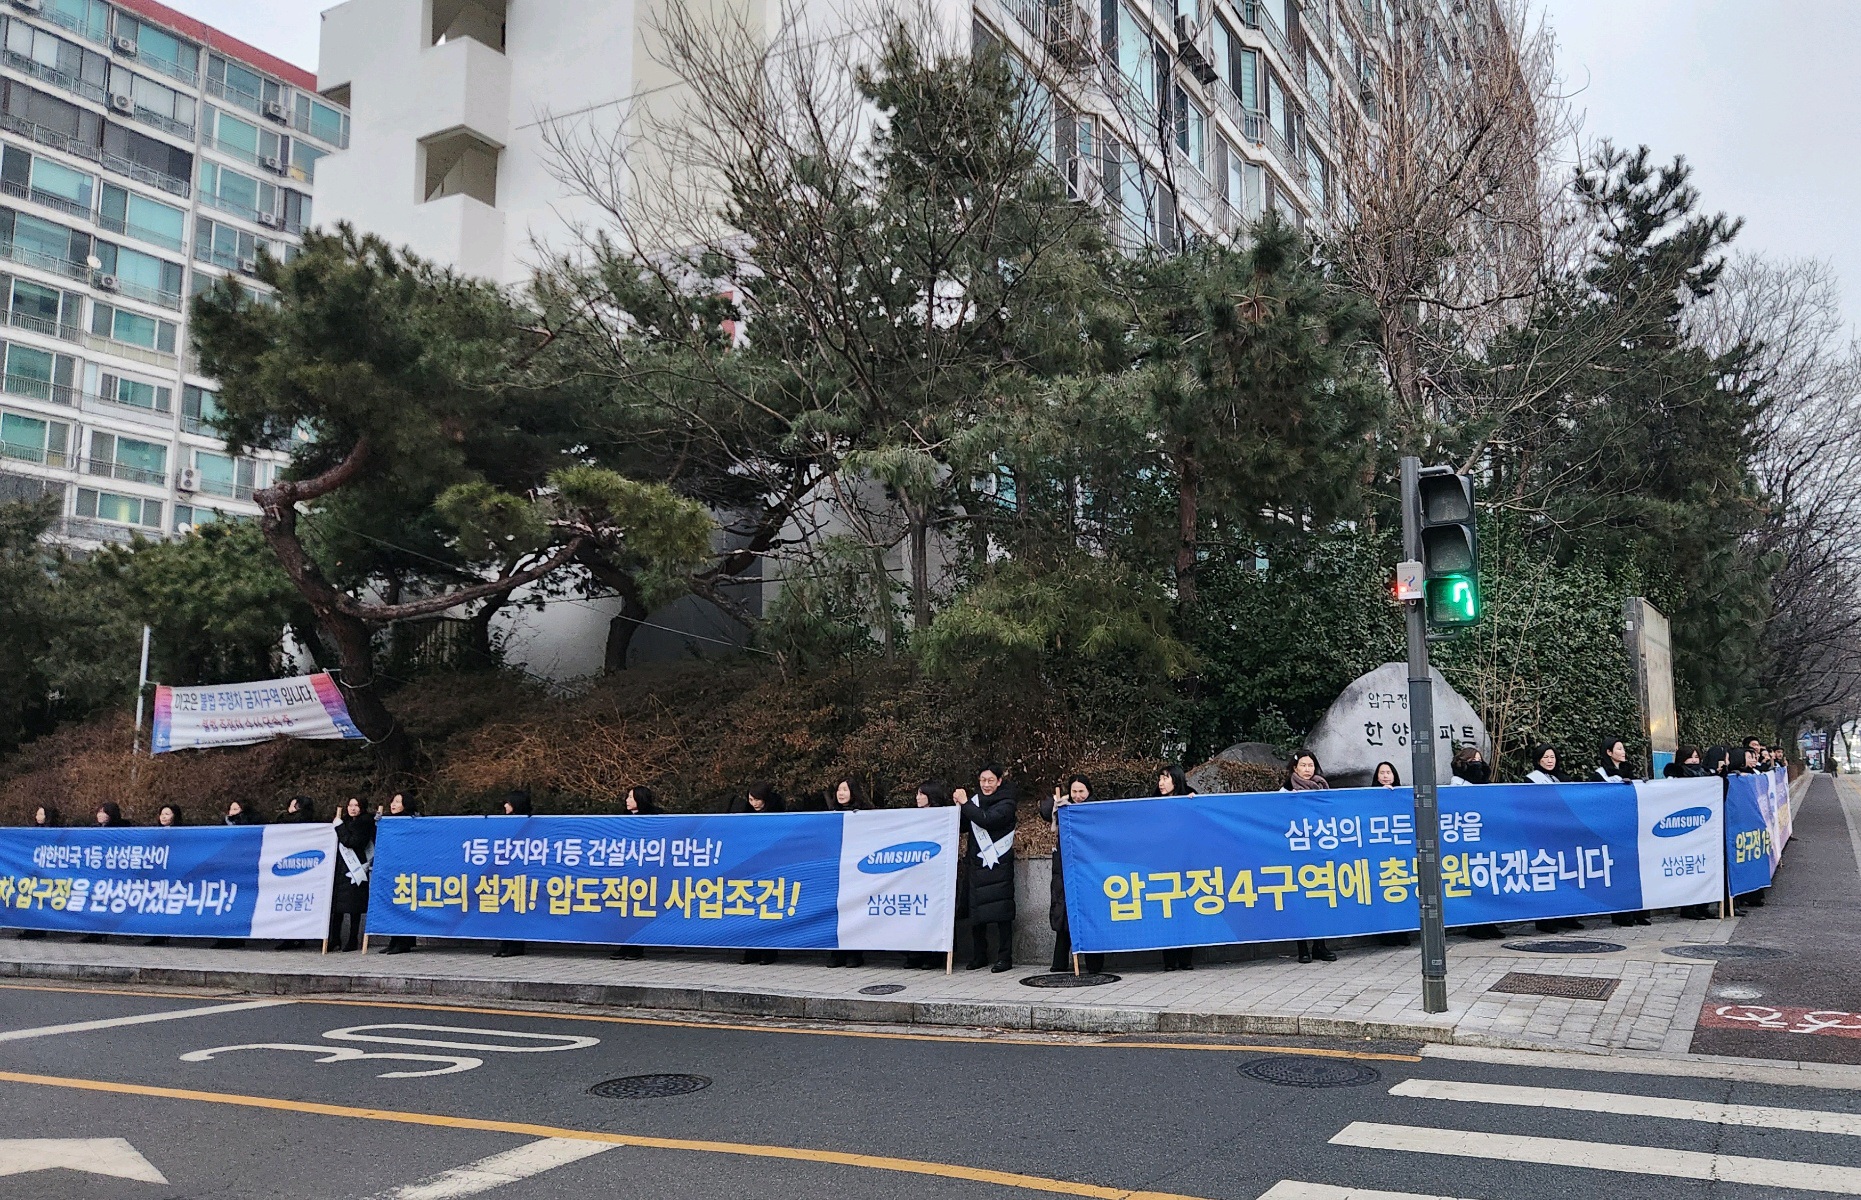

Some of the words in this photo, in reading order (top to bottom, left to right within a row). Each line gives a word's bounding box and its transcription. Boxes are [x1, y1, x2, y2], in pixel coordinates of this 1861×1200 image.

[175, 693, 198, 710] 이곳은
[200, 692, 216, 711] 불법
[217, 691, 243, 710] 주정차
[244, 688, 282, 709] 금지구역
[1368, 692, 1408, 709] 압구정
[1364, 721, 1476, 746] 한양파트
[1284, 815, 1363, 851] 삼성의
[1368, 814, 1414, 845] 모든
[1439, 811, 1483, 843] 량을
[1660, 814, 1706, 829] SAMSUNG
[33, 845, 82, 869] 대한민국
[83, 845, 103, 869] 1등
[105, 845, 170, 870] 삼성물산이
[462, 838, 490, 866] 1등
[493, 837, 550, 866] 단지와
[553, 838, 583, 867] 1등
[586, 838, 666, 868] 건설사의
[671, 838, 723, 867] 만남!
[867, 850, 931, 865] SAMSUNG
[1736, 829, 1762, 864] 압구정
[276, 857, 320, 870] SAMSUNG
[1661, 853, 1706, 877] 삼성물산
[1103, 858, 1372, 922] 압구정4구역에
[1378, 844, 1614, 903] 총원하겠습니다
[16, 877, 90, 912] 압구정을
[90, 879, 238, 916] 완성하겠습니다!
[275, 893, 315, 912] 삼성물산
[392, 873, 469, 913] 최고의
[474, 873, 540, 914] 설계!
[546, 875, 658, 918] 압도적인
[664, 876, 802, 920] 사업조건!
[867, 894, 929, 917] 삼성물산
